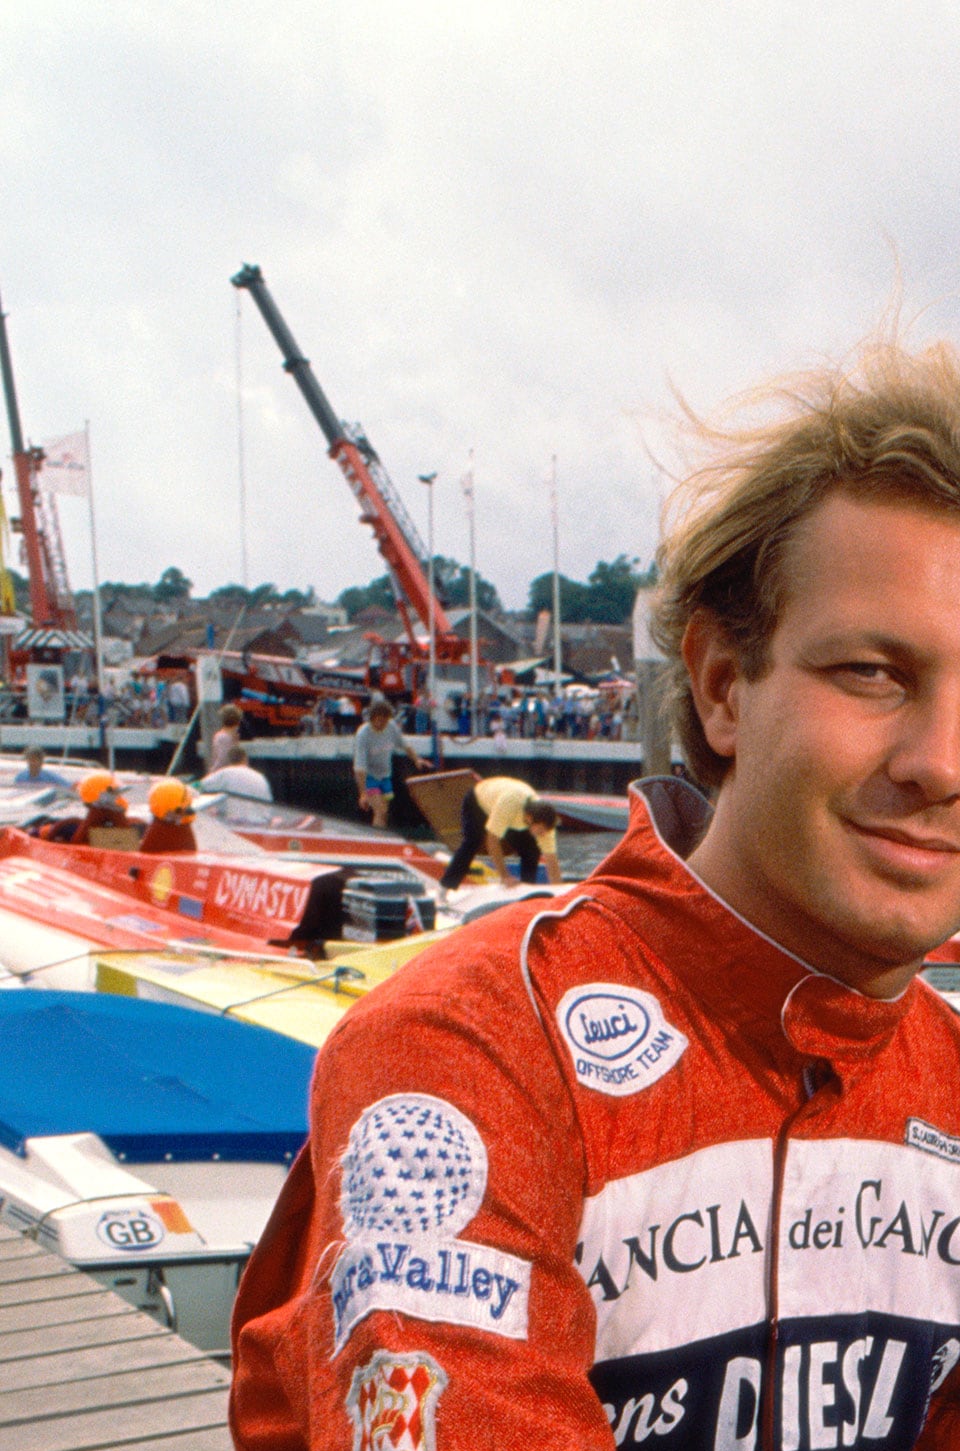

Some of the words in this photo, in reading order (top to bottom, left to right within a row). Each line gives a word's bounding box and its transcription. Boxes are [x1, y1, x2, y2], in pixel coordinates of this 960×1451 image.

[215, 870, 310, 921] DYNASTY
[576, 1058, 640, 1085] OFFSHORE
[636, 1030, 675, 1070] TEAM
[105, 1220, 155, 1246] GB
[575, 1199, 764, 1302] ANCIA
[789, 1207, 845, 1250] dei
